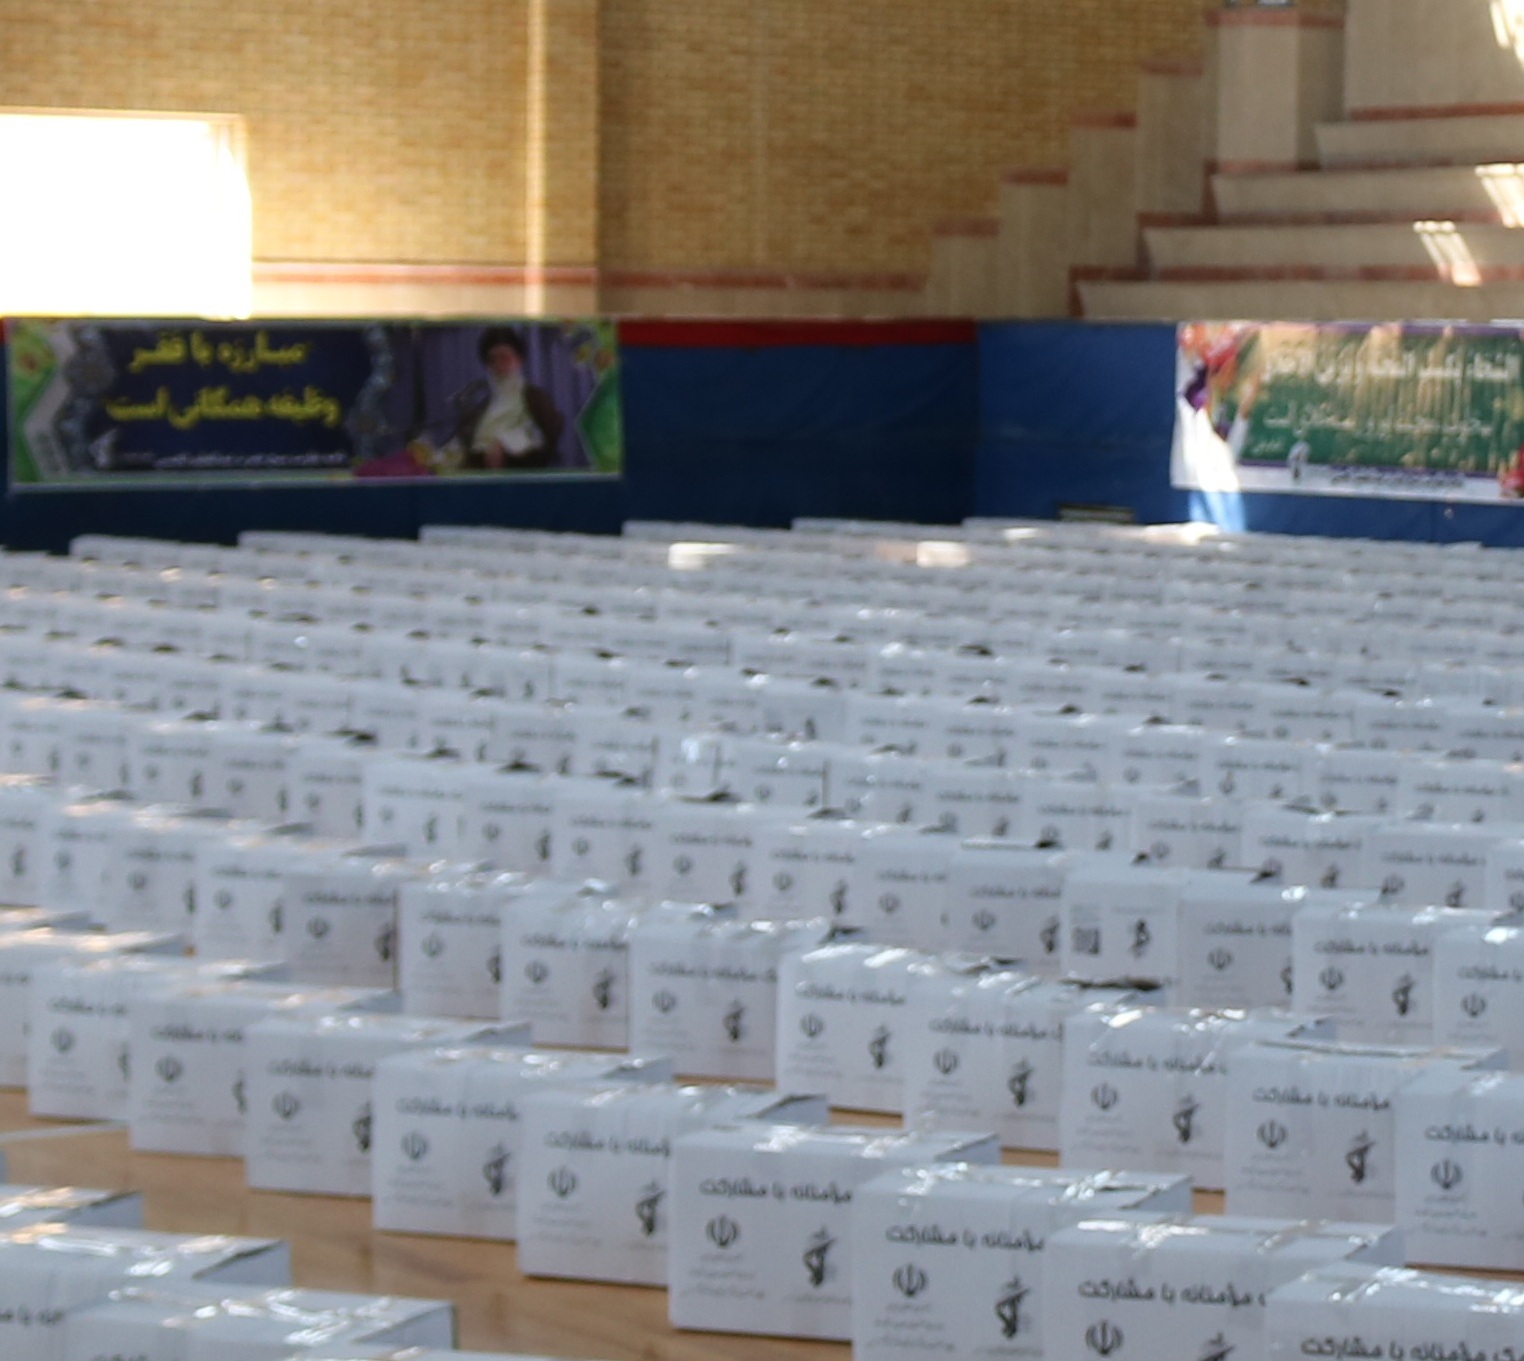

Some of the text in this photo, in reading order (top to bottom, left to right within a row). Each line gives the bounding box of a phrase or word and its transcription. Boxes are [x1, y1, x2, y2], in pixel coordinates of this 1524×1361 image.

[128, 329, 186, 373] فقر
[190, 331, 213, 367] با
[106, 385, 169, 420] است
[1494, 1128, 1506, 1147] با
[773, 1181, 786, 1202] با
[963, 1229, 977, 1250] با
[1078, 1279, 1157, 1303] مشارکت
[1163, 1283, 1175, 1305] با
